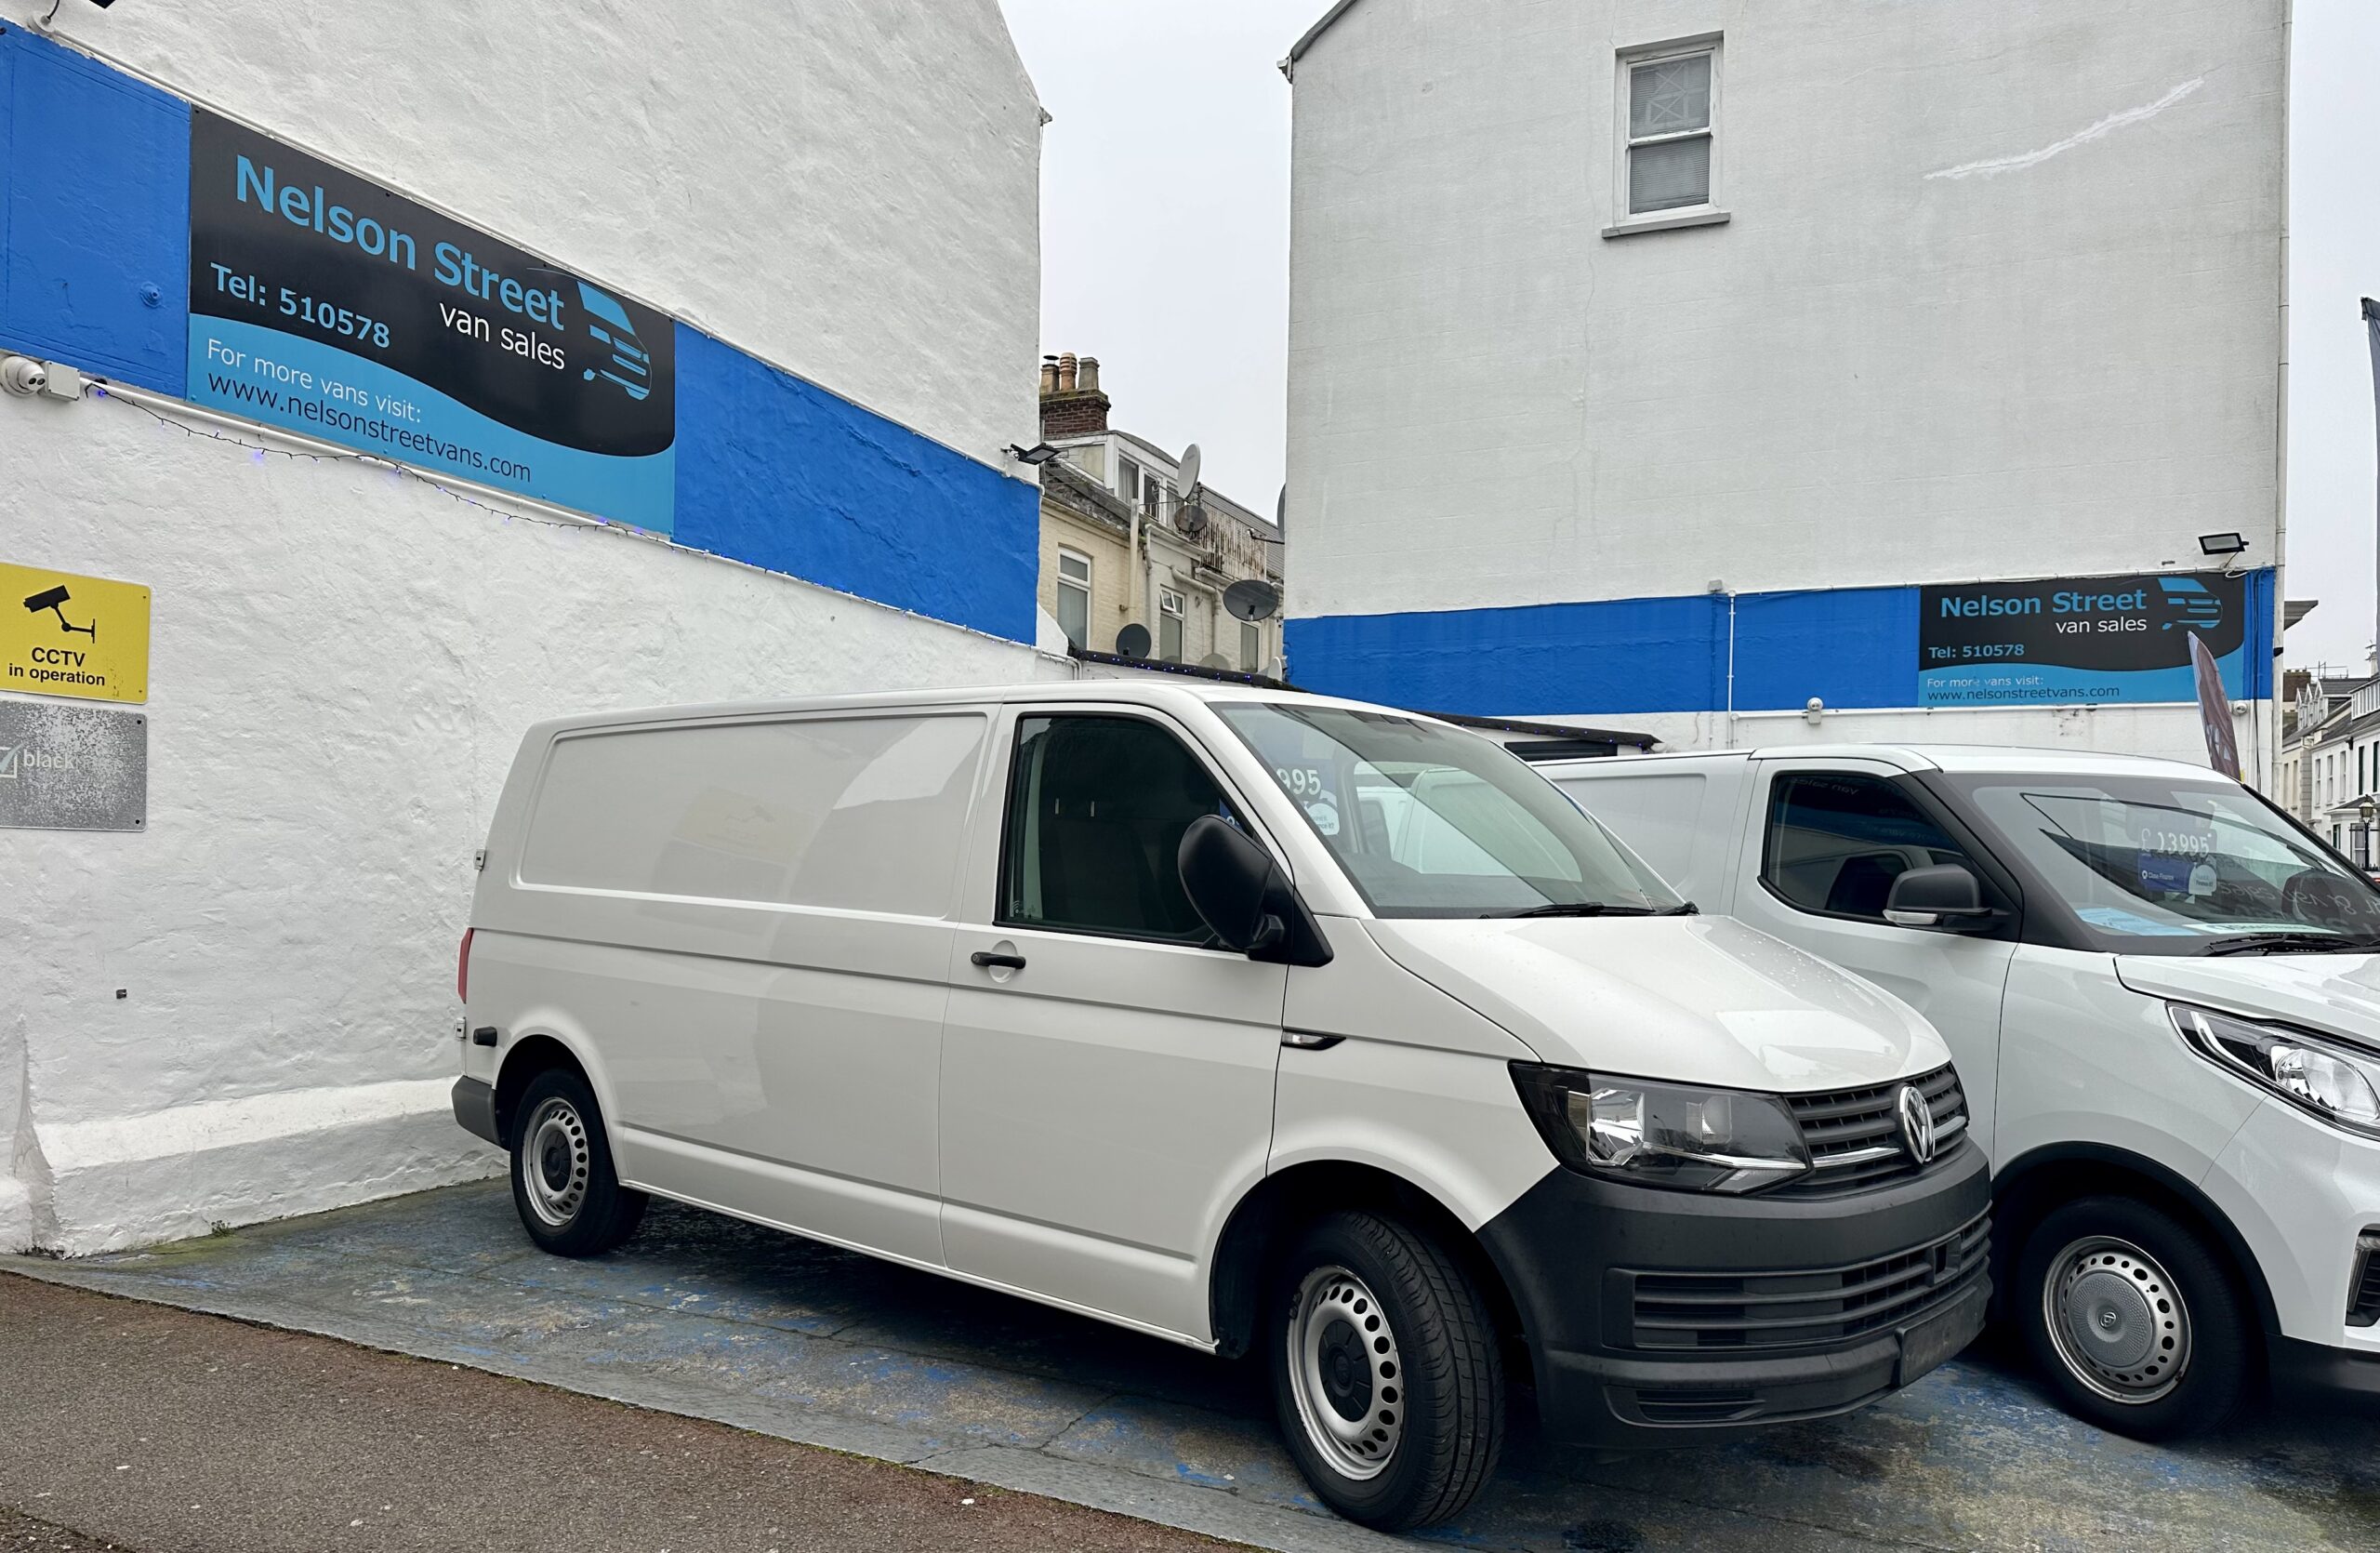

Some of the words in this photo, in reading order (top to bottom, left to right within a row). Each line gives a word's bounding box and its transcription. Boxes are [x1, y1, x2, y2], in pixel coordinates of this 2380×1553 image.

[235, 153, 416, 271] Nelson
[433, 240, 564, 331] Street
[210, 262, 267, 306] Tel:
[279, 287, 390, 349] 510578
[439, 301, 490, 342] van
[500, 322, 564, 370] sales
[207, 338, 245, 369] For
[255, 355, 313, 390] more
[320, 379, 368, 407] vans
[375, 393, 421, 423] visit:
[207, 371, 531, 484] www.nelsonstreetvans.com
[1940, 595, 2042, 618] Nelson
[2052, 589, 2148, 614] Street
[2056, 620, 2091, 634] van
[2097, 616, 2148, 632] sales
[31, 646, 86, 668] CCTV
[1928, 646, 1957, 659] Tel:
[1962, 644, 2025, 657] 510578
[8, 662, 24, 678] in
[29, 669, 105, 686] operation
[1927, 678, 1946, 688] For
[1984, 677, 2012, 686] vans
[2016, 675, 2044, 685] visit:
[1927, 685, 2120, 700] www.nelsonstreetvans.com
